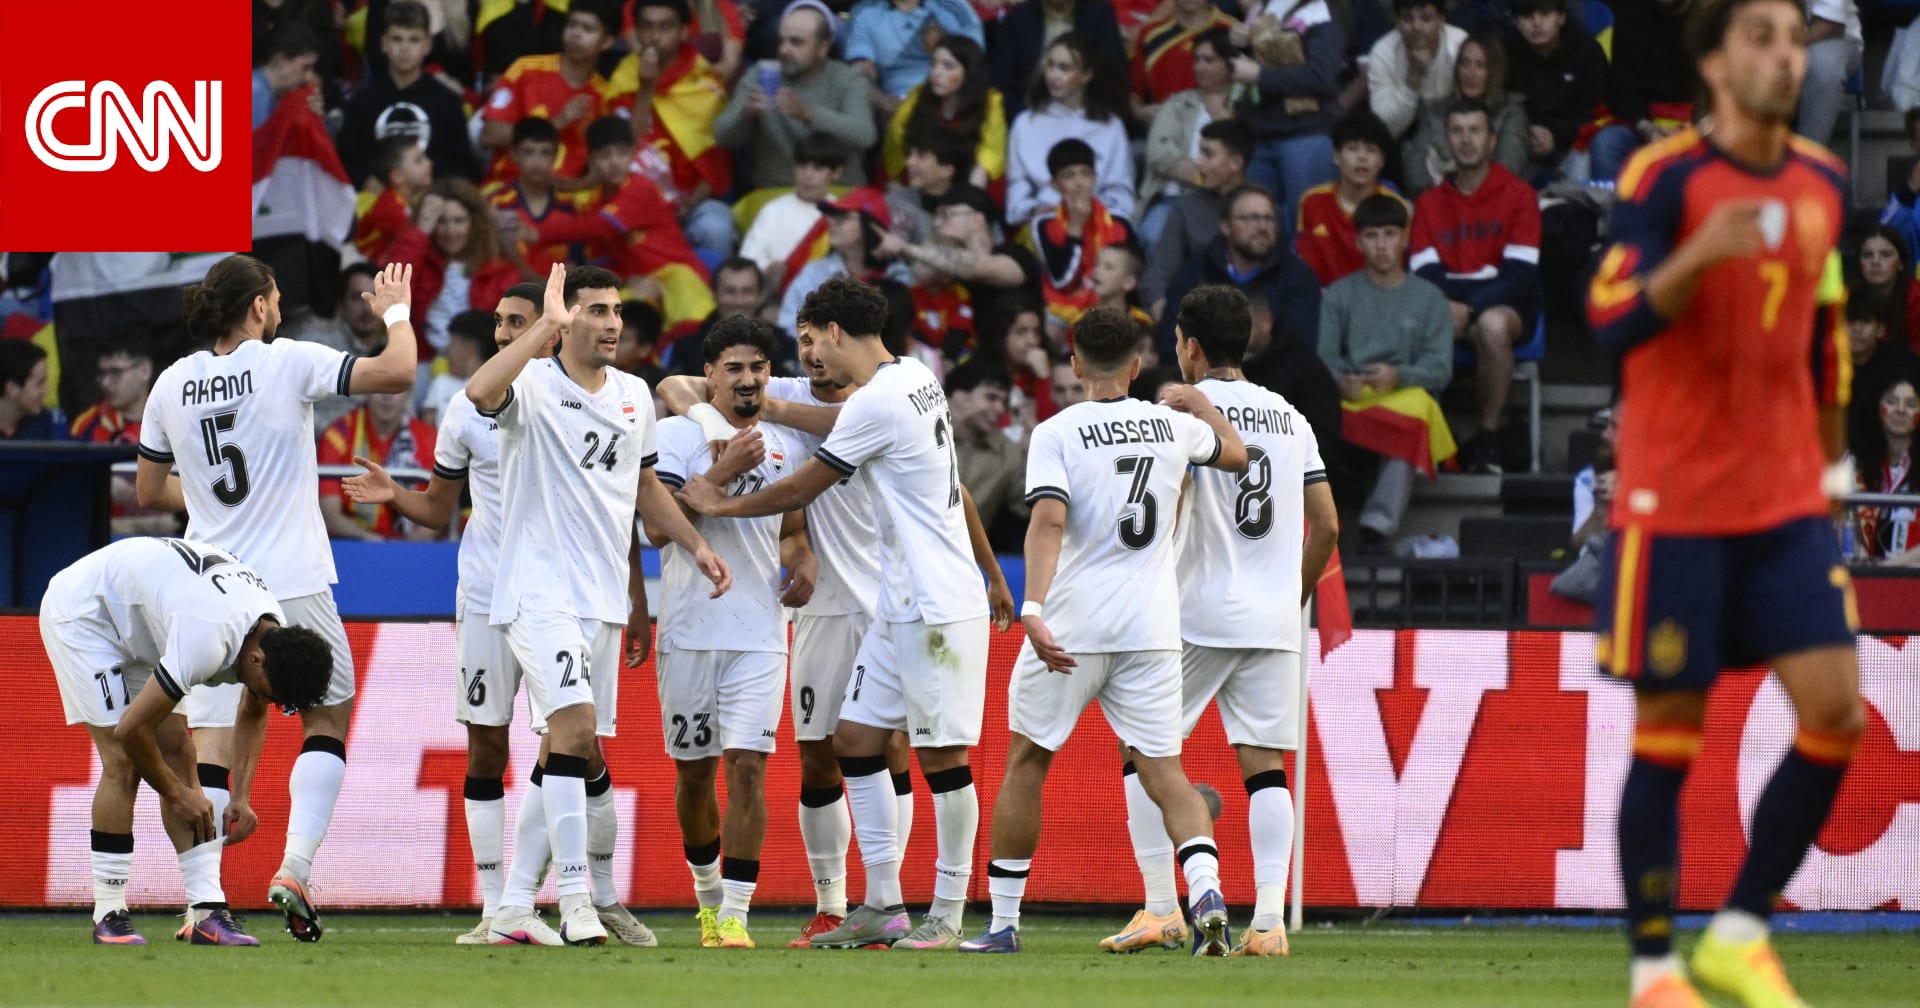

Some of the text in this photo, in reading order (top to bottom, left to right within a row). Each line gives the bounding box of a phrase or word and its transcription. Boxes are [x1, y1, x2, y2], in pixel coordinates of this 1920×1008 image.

[1760, 261, 1788, 333] 7
[182, 370, 252, 406] AKAM
[560, 400, 582, 410] JAKO
[579, 431, 620, 471] 24
[1078, 418, 1175, 449] HUSSEIN
[200, 410, 250, 507] 5
[1113, 455, 1158, 550] 3
[1235, 445, 1274, 540] 8
[800, 686, 815, 724] 9
[671, 713, 712, 749] 23
[562, 864, 588, 873] JAKO
